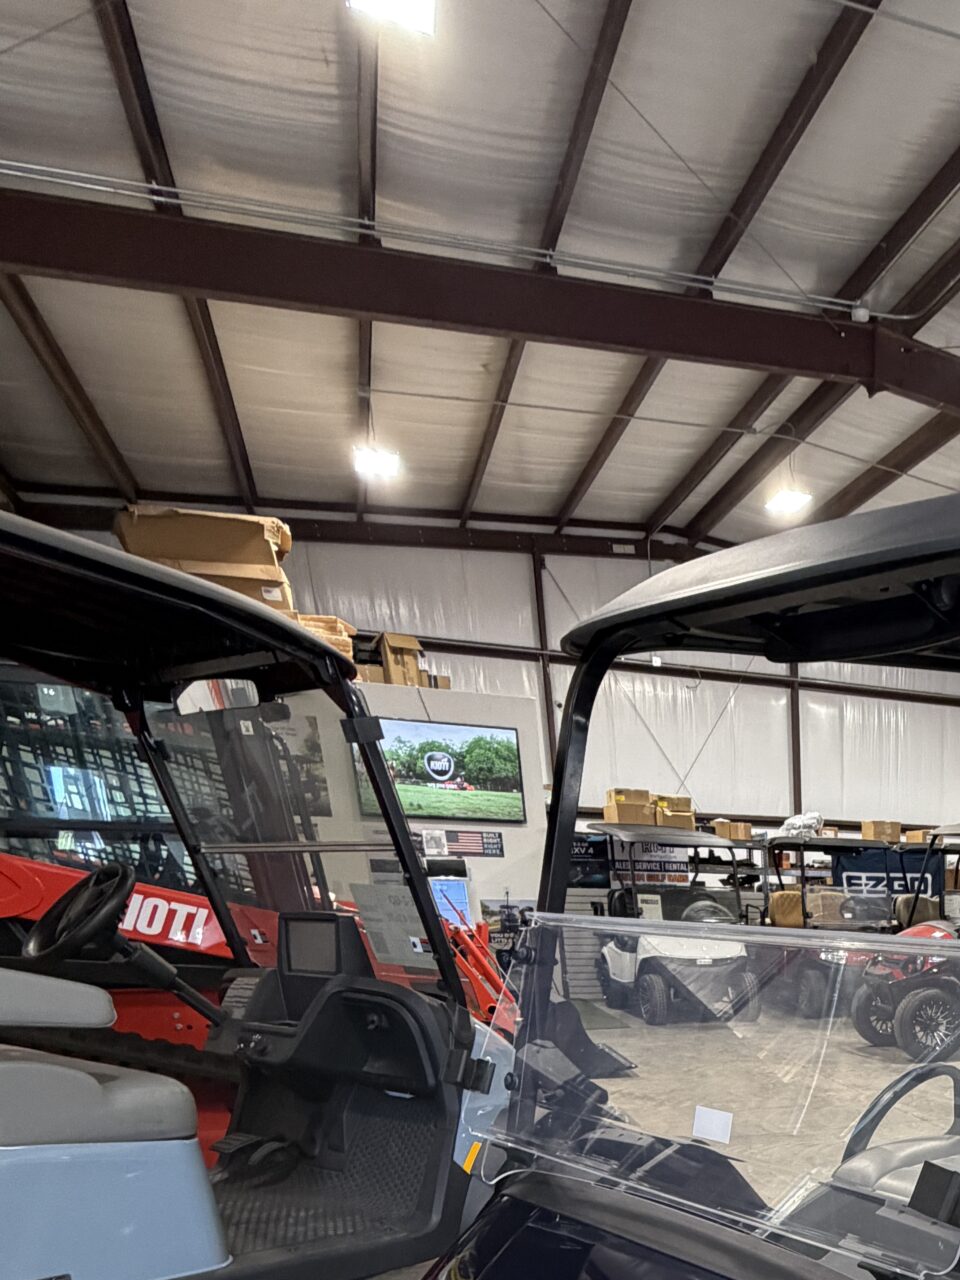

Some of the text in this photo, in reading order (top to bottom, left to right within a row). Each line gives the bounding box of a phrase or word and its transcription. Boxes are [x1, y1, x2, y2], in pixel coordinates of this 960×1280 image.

[634, 861, 661, 870] SERVICE
[665, 862, 688, 871] RENTAL
[118, 893, 209, 946] IOTI
